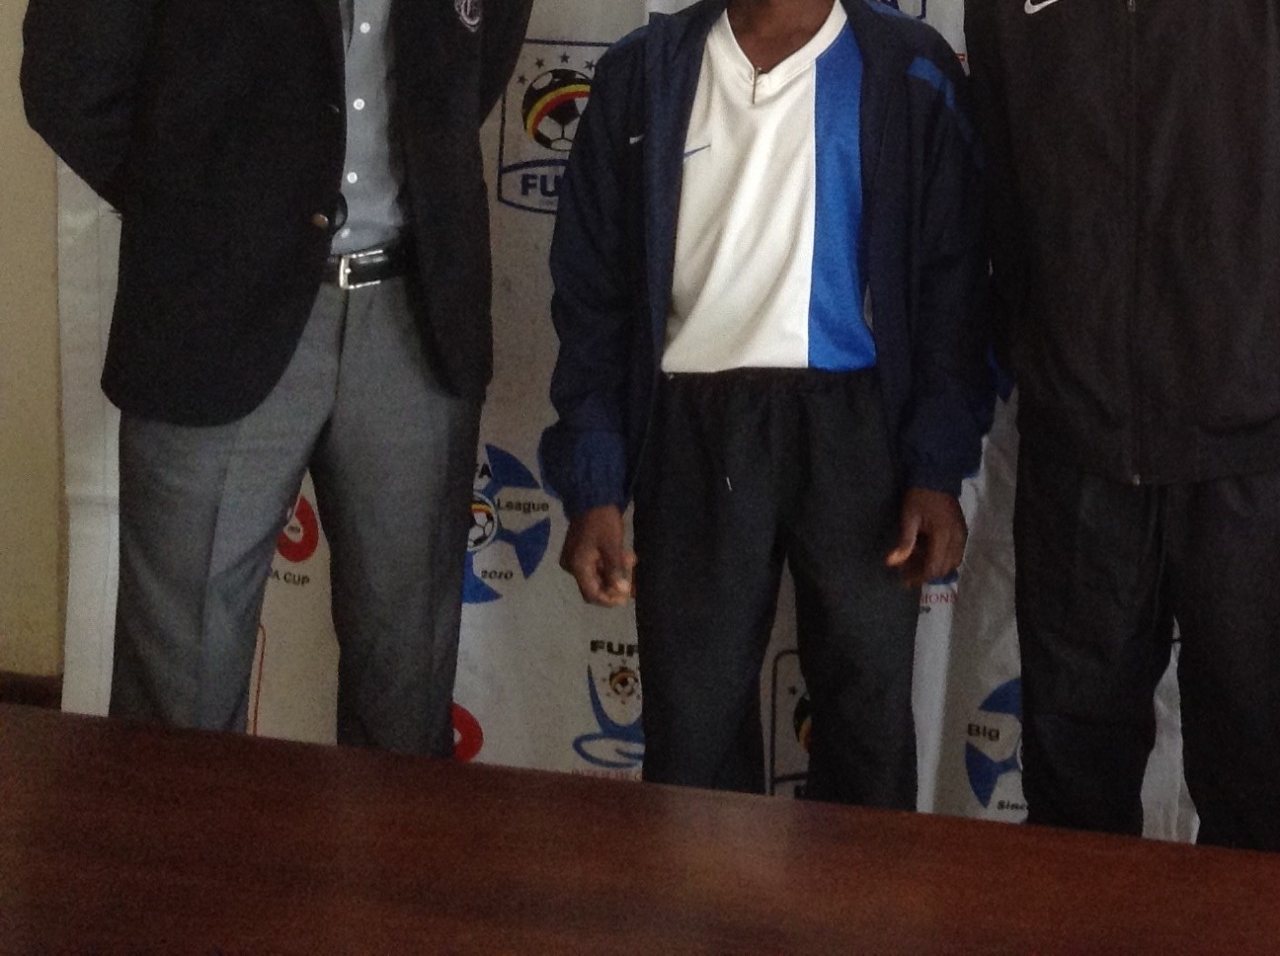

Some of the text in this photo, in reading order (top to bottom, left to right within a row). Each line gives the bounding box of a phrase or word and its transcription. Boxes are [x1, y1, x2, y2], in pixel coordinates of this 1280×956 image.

[520, 174, 560, 197] FU
[497, 498, 549, 514] League
[284, 574, 310, 586] CUP
[481, 569, 513, 580] 2010
[590, 639, 638, 657] FUF
[967, 723, 1000, 741] Big
